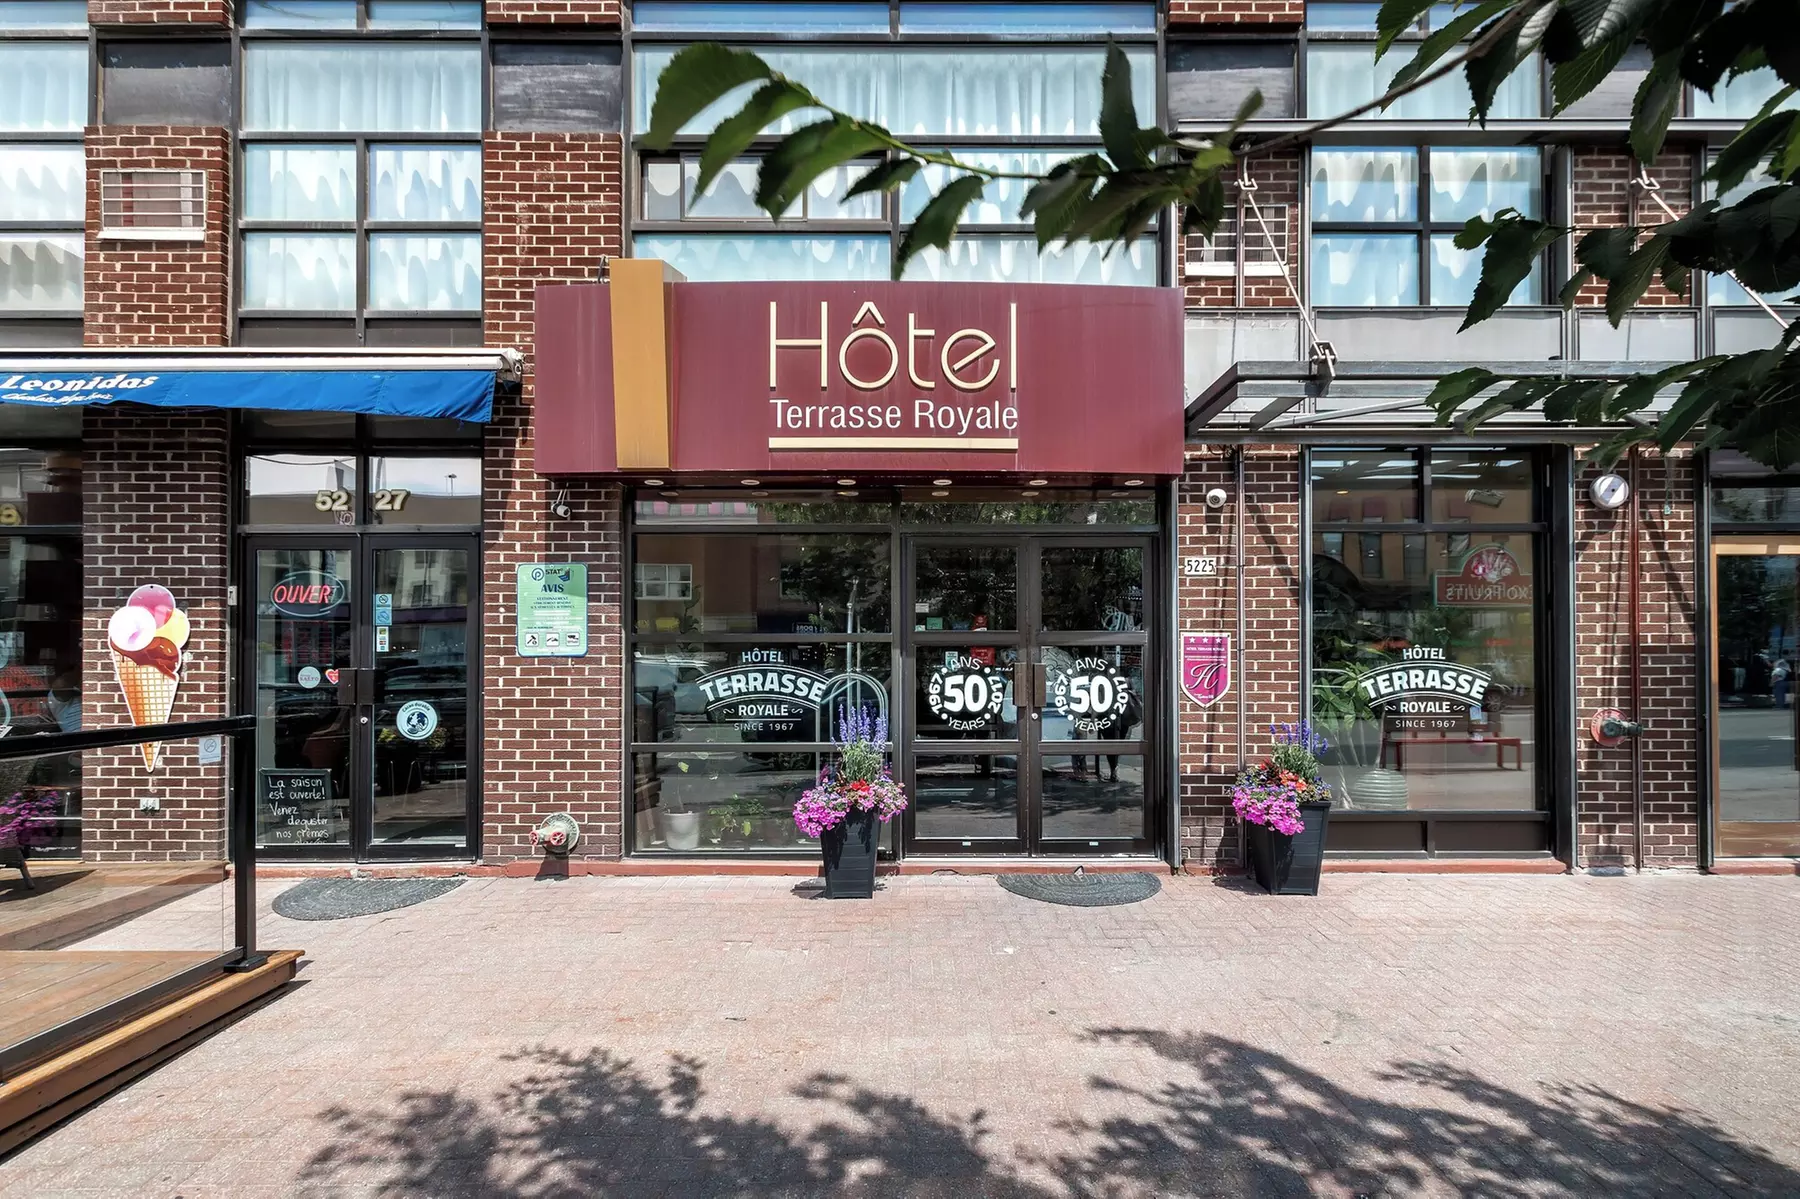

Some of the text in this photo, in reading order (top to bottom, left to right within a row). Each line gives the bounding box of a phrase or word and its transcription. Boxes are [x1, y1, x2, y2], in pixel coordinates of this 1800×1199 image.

[769, 301, 1017, 391] Hôtel
[0, 374, 160, 391] Leonidas
[769, 399, 1019, 436] Terrasse Royale
[315, 489, 411, 511] 52 27
[1186, 559, 1215, 573] 5225
[273, 584, 341, 604] OUVERT
[541, 583, 565, 593] AVIS
[741, 647, 785, 663] HÔTEL
[1402, 644, 1446, 660] HÔTEL
[950, 656, 984, 672] ANS
[1075, 656, 1109, 672] ANS
[1185, 662, 1227, 690] H
[699, 672, 827, 702] TERRASSE
[1360, 669, 1489, 700] TERRASSE
[929, 672, 944, 716] 1967
[943, 674, 988, 713] 50
[988, 676, 1004, 714] 2017
[1054, 674, 1069, 716] 1967
[1070, 674, 1115, 713] 50
[1113, 676, 1129, 714] 2017
[738, 704, 789, 716] ROYALE
[1400, 701, 1451, 713] ROYALE
[733, 722, 794, 731] SINCE 1967
[948, 717, 986, 731] YEARS
[1073, 718, 1111, 732] YEARS
[1395, 720, 1456, 728] SINCE 1967
[268, 776, 323, 788] La saison
[269, 787, 325, 800] est ouverte!
[269, 801, 299, 816] Venez
[276, 830, 292, 839] nos
